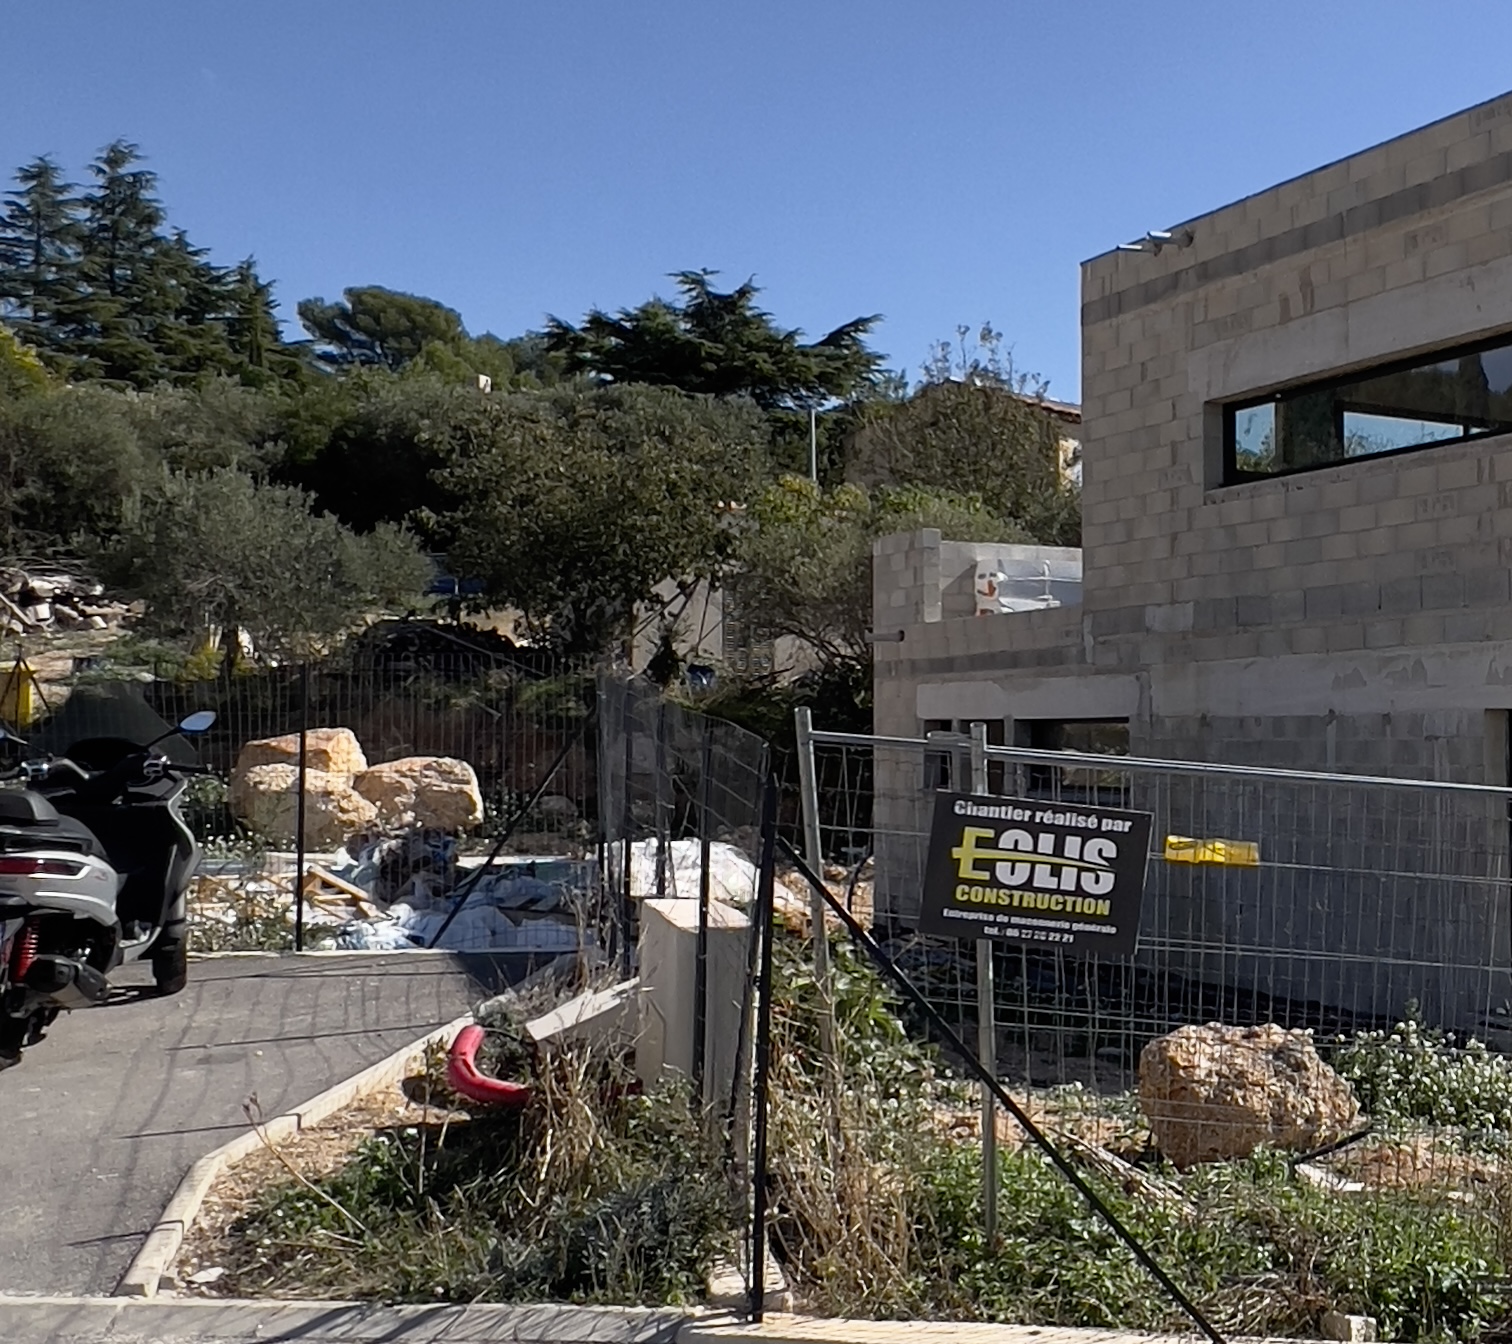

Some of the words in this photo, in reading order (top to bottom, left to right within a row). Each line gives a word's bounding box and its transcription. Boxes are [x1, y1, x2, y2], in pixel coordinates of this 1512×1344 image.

[954, 800, 1032, 822] Chantier
[1034, 809, 1098, 829] réalisé
[1101, 819, 1132, 832] par
[951, 826, 1119, 895] EOLIS
[943, 908, 995, 921] Entreprise
[996, 913, 1009, 923] de
[955, 884, 1111, 916] CONSTRUCTION
